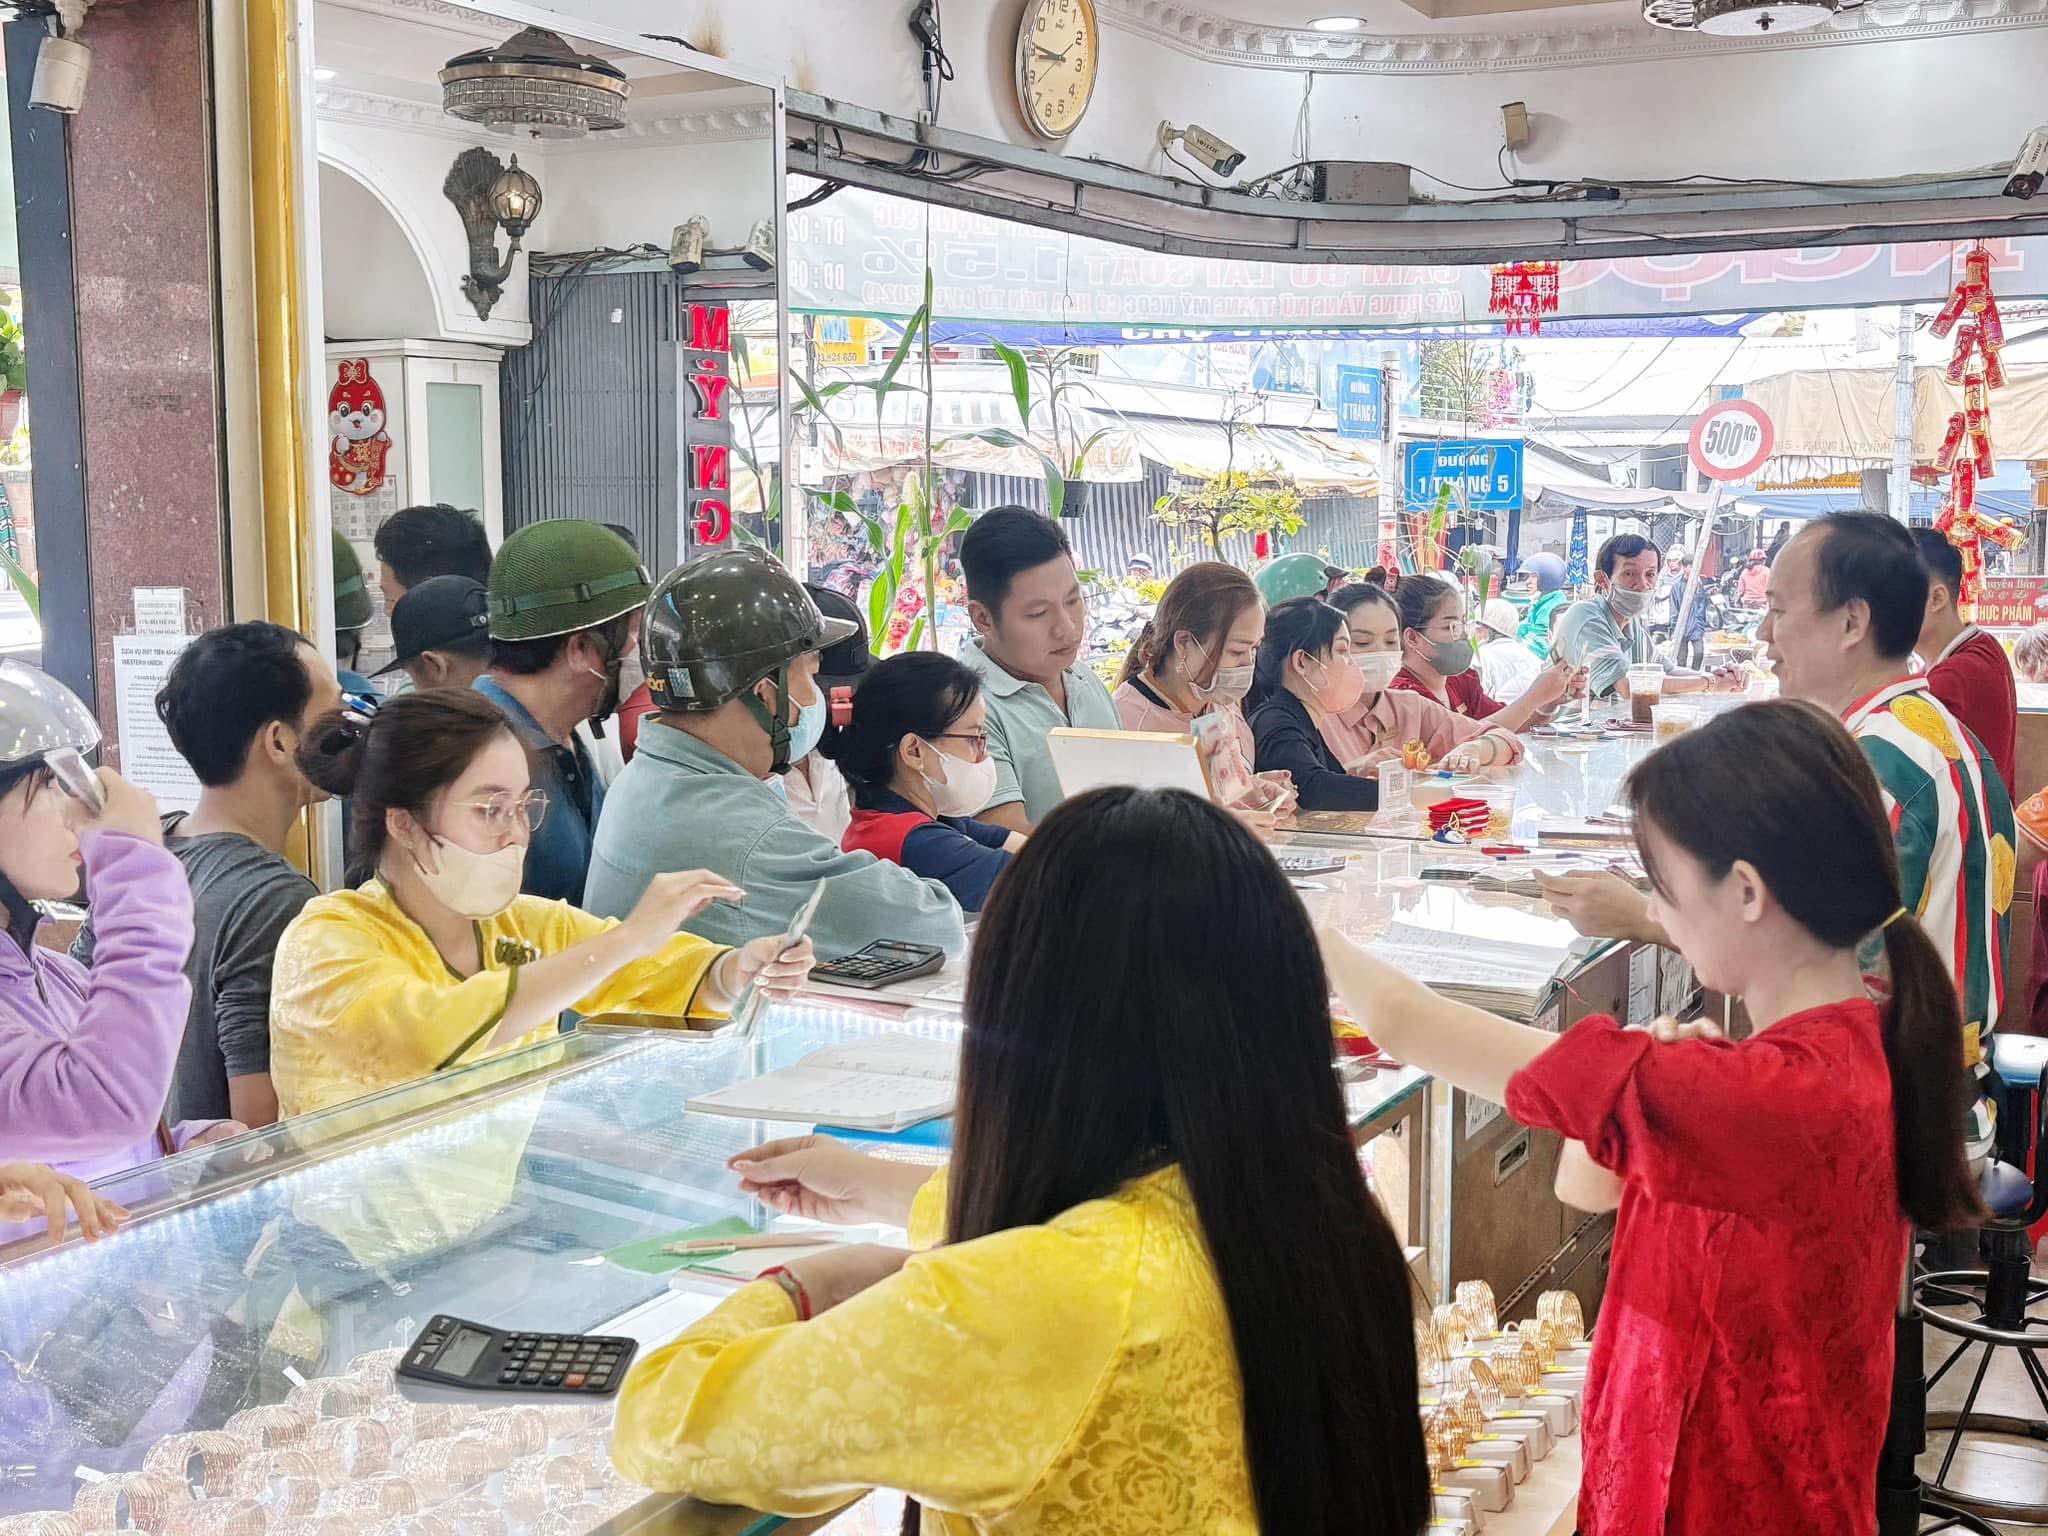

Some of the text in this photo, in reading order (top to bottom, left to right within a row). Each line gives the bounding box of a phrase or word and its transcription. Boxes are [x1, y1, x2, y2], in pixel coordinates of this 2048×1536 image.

[1075, 30, 1083, 46] 2
[1074, 58, 1082, 73] 3
[1068, 83, 1076, 97] 4
[1035, 92, 1043, 107] 7
[1057, 99, 1065, 114] 5
[1045, 102, 1053, 118] 6
[1704, 419, 1742, 458] 500
[1743, 426, 1758, 442] KG
[1438, 451, 1490, 467] ĐƯỜNG
[1418, 476, 1426, 494] 1
[1498, 474, 1509, 492] 5
[2001, 599, 2033, 622] PHẨM
